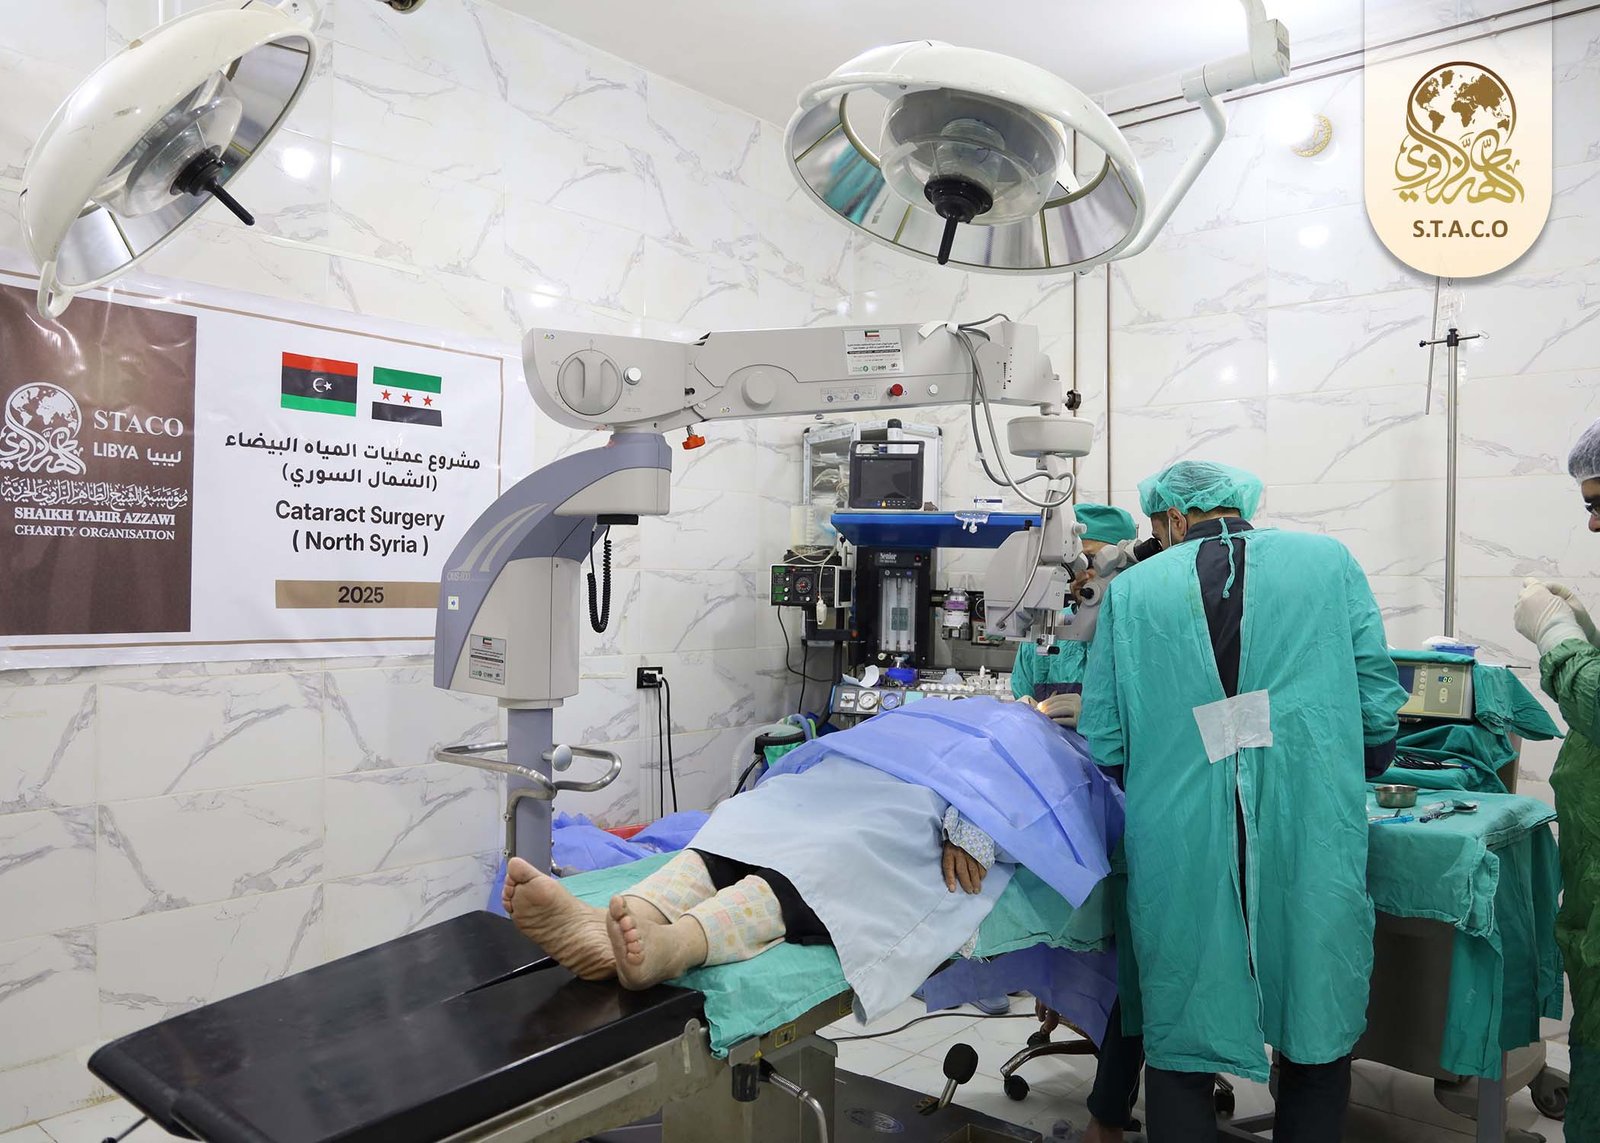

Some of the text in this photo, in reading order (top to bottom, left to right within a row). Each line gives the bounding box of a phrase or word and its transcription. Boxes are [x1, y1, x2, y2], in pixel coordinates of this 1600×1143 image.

[93, 409, 184, 437] STACO
[93, 441, 139, 460] LIBYA
[147, 447, 182, 467] ليبيا
[225, 432, 481, 472] مشروع عمليات المياه البيضاء
[282, 463, 438, 491] (الشمال السوري)
[14, 507, 175, 526] SHAIKH TAHIR AZZAWI
[275, 500, 445, 531] Cataract Surgery
[14, 524, 175, 540] CHARITY ORGANISATION
[305, 531, 364, 551] North
[369, 534, 417, 557] Syria
[338, 586, 384, 604] 2025
